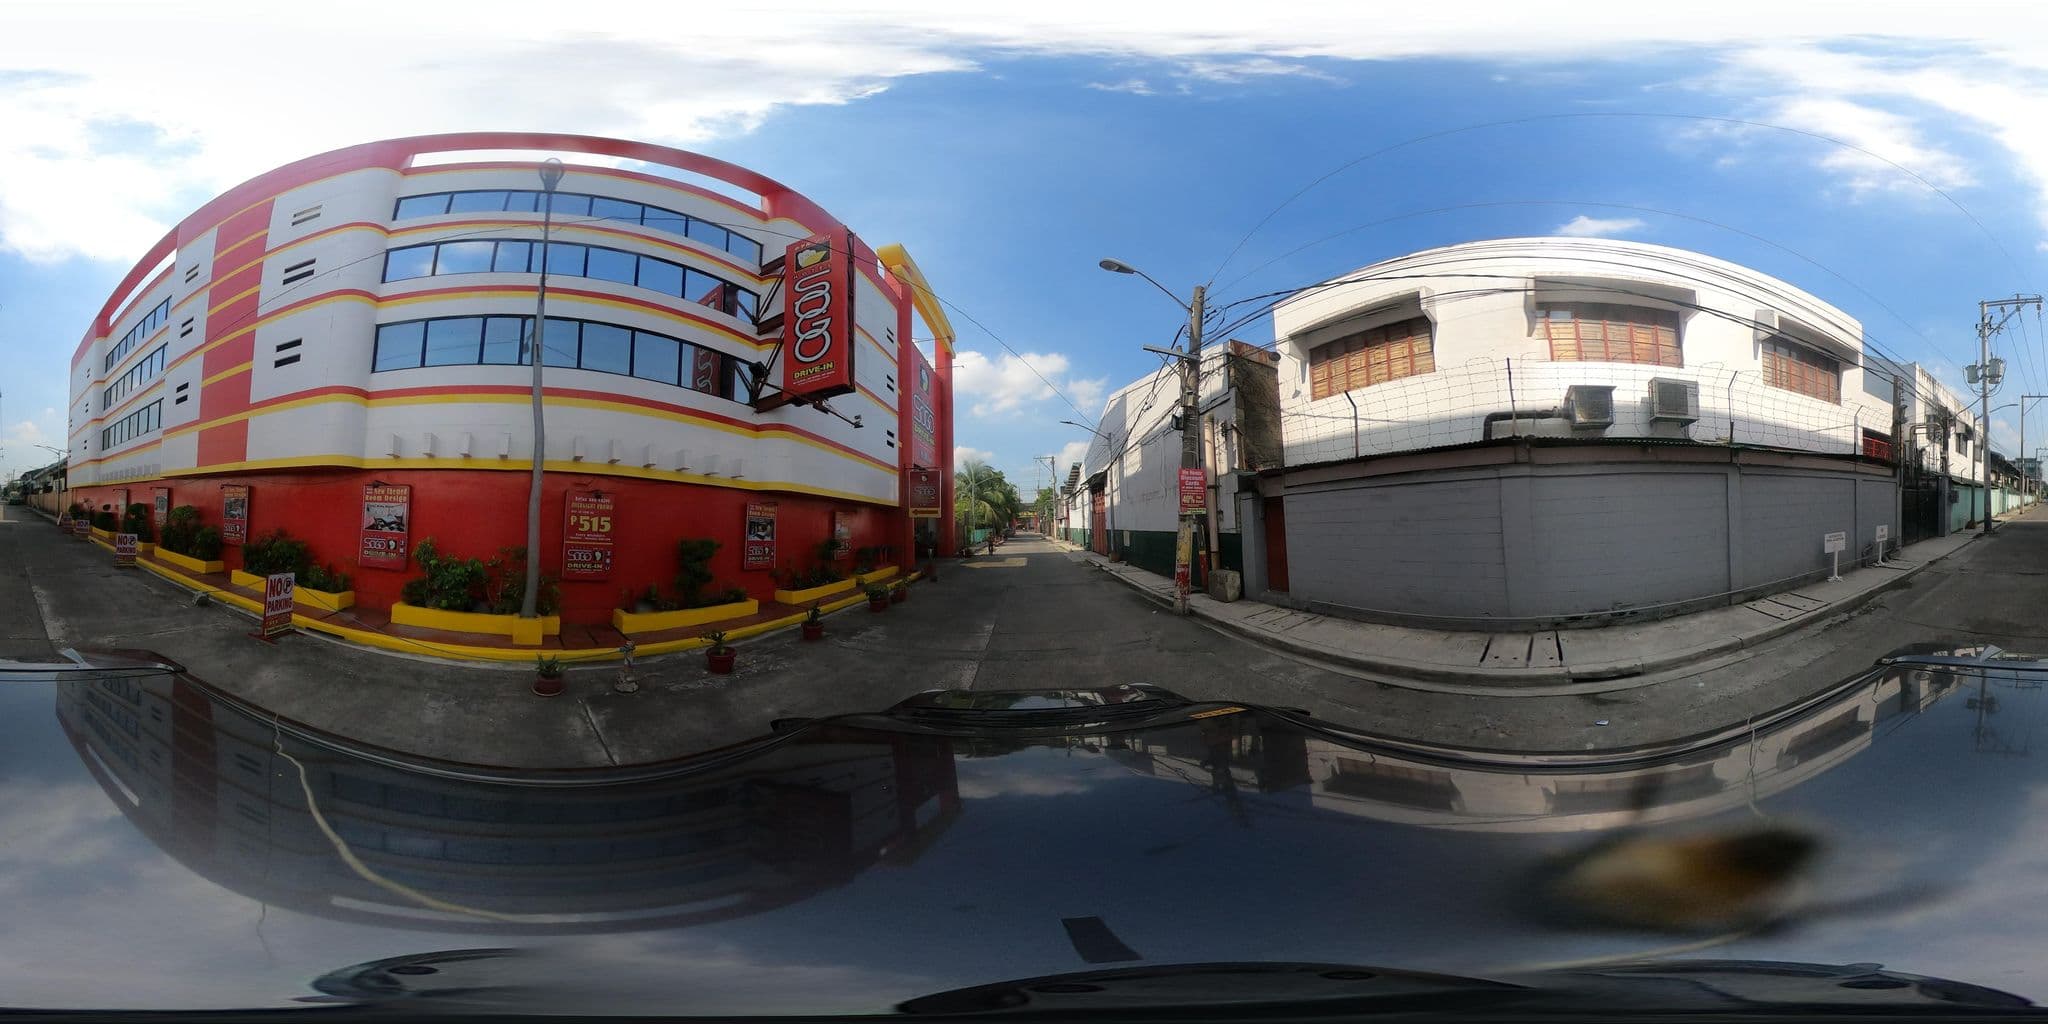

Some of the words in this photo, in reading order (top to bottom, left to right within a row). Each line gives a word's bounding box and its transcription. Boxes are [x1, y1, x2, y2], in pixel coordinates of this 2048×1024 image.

[794, 269, 831, 363] SOGO
[794, 361, 834, 379] DRIVE-IN
[118, 535, 128, 546] NO
[567, 562, 603, 570] DRIVE-IN
[269, 577, 283, 598] NO
[267, 597, 292, 613] PARKING
